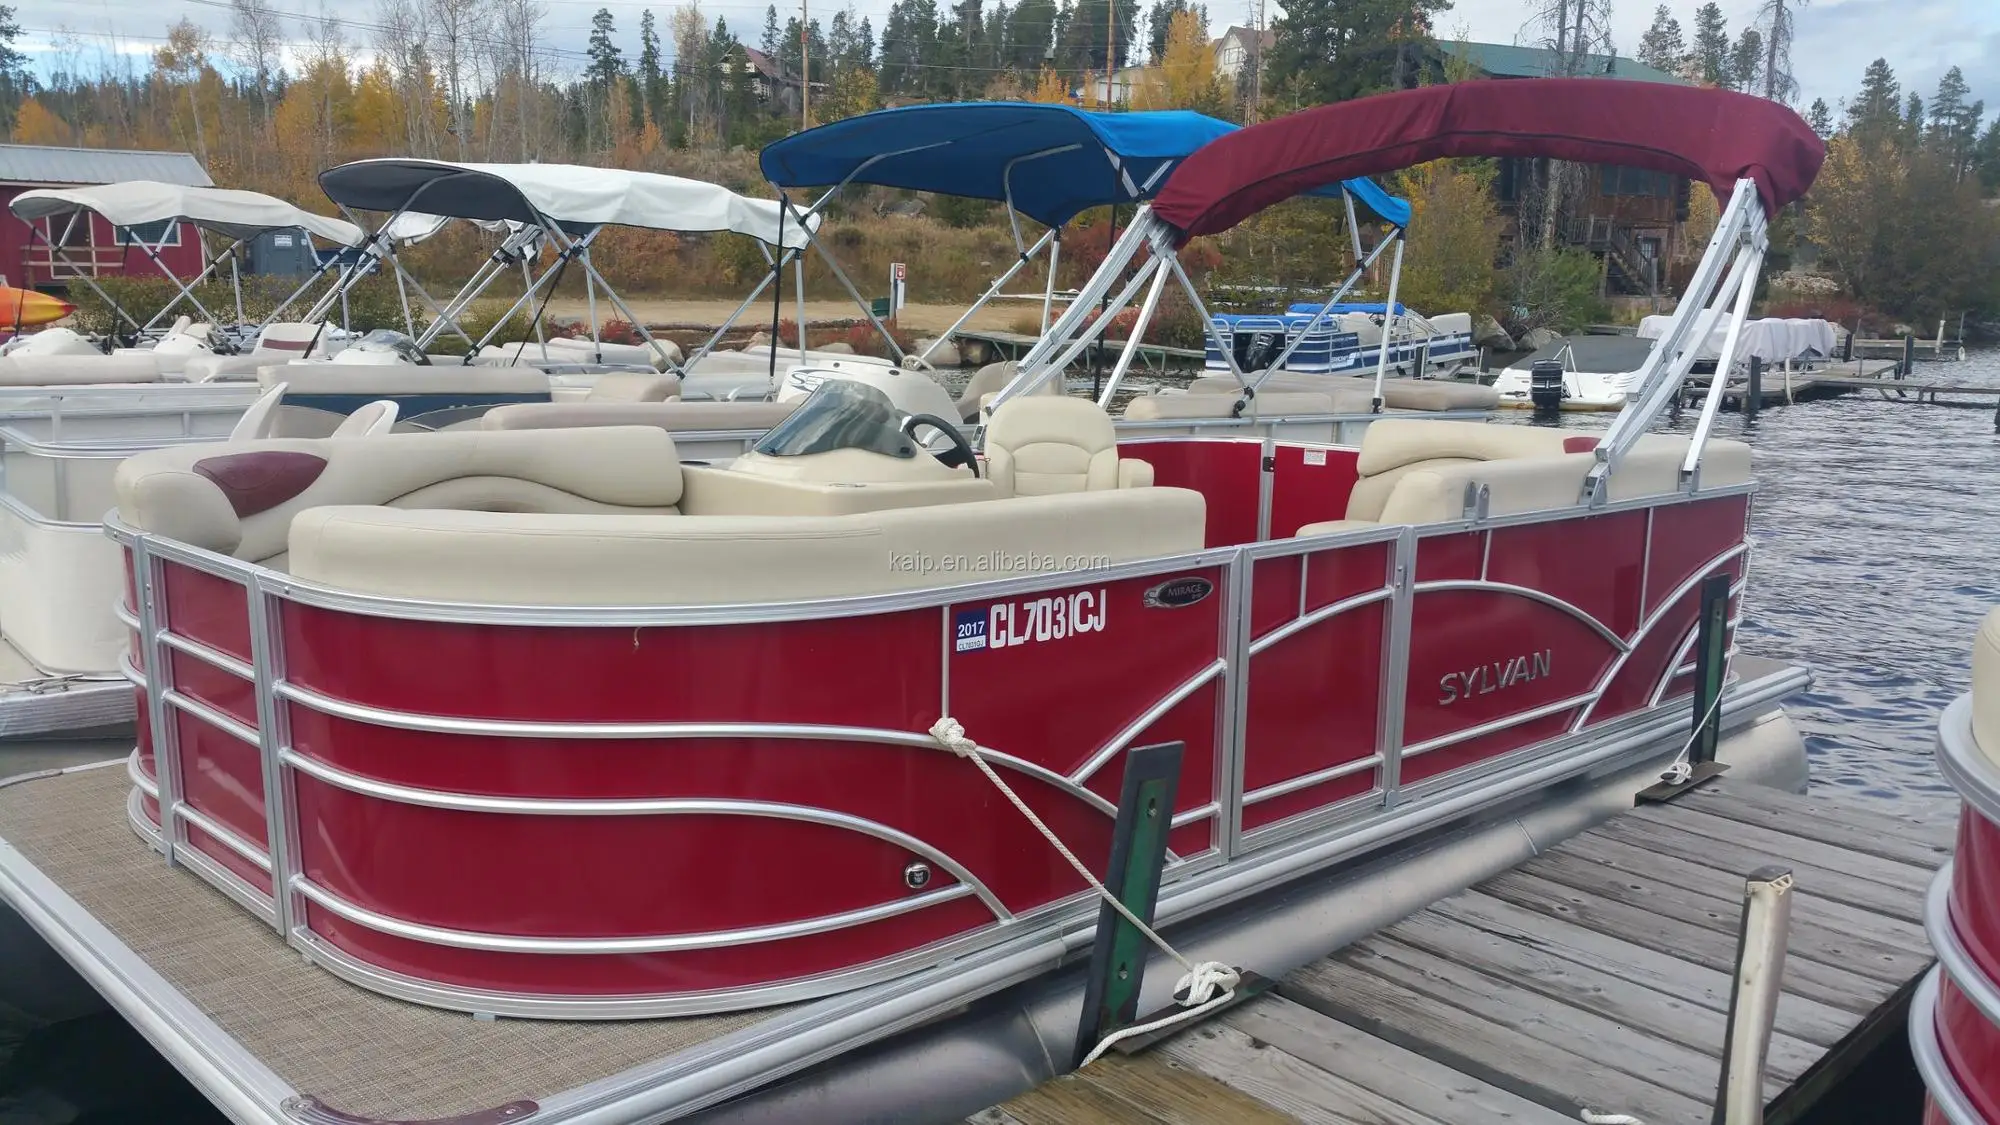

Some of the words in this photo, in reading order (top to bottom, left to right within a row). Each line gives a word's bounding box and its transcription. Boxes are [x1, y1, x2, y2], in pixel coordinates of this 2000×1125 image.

[1168, 584, 1201, 597] MIRAGE
[958, 621, 985, 637] 2017
[989, 589, 1107, 649] CL7031CJ
[1439, 649, 1550, 705] SYLVAN
